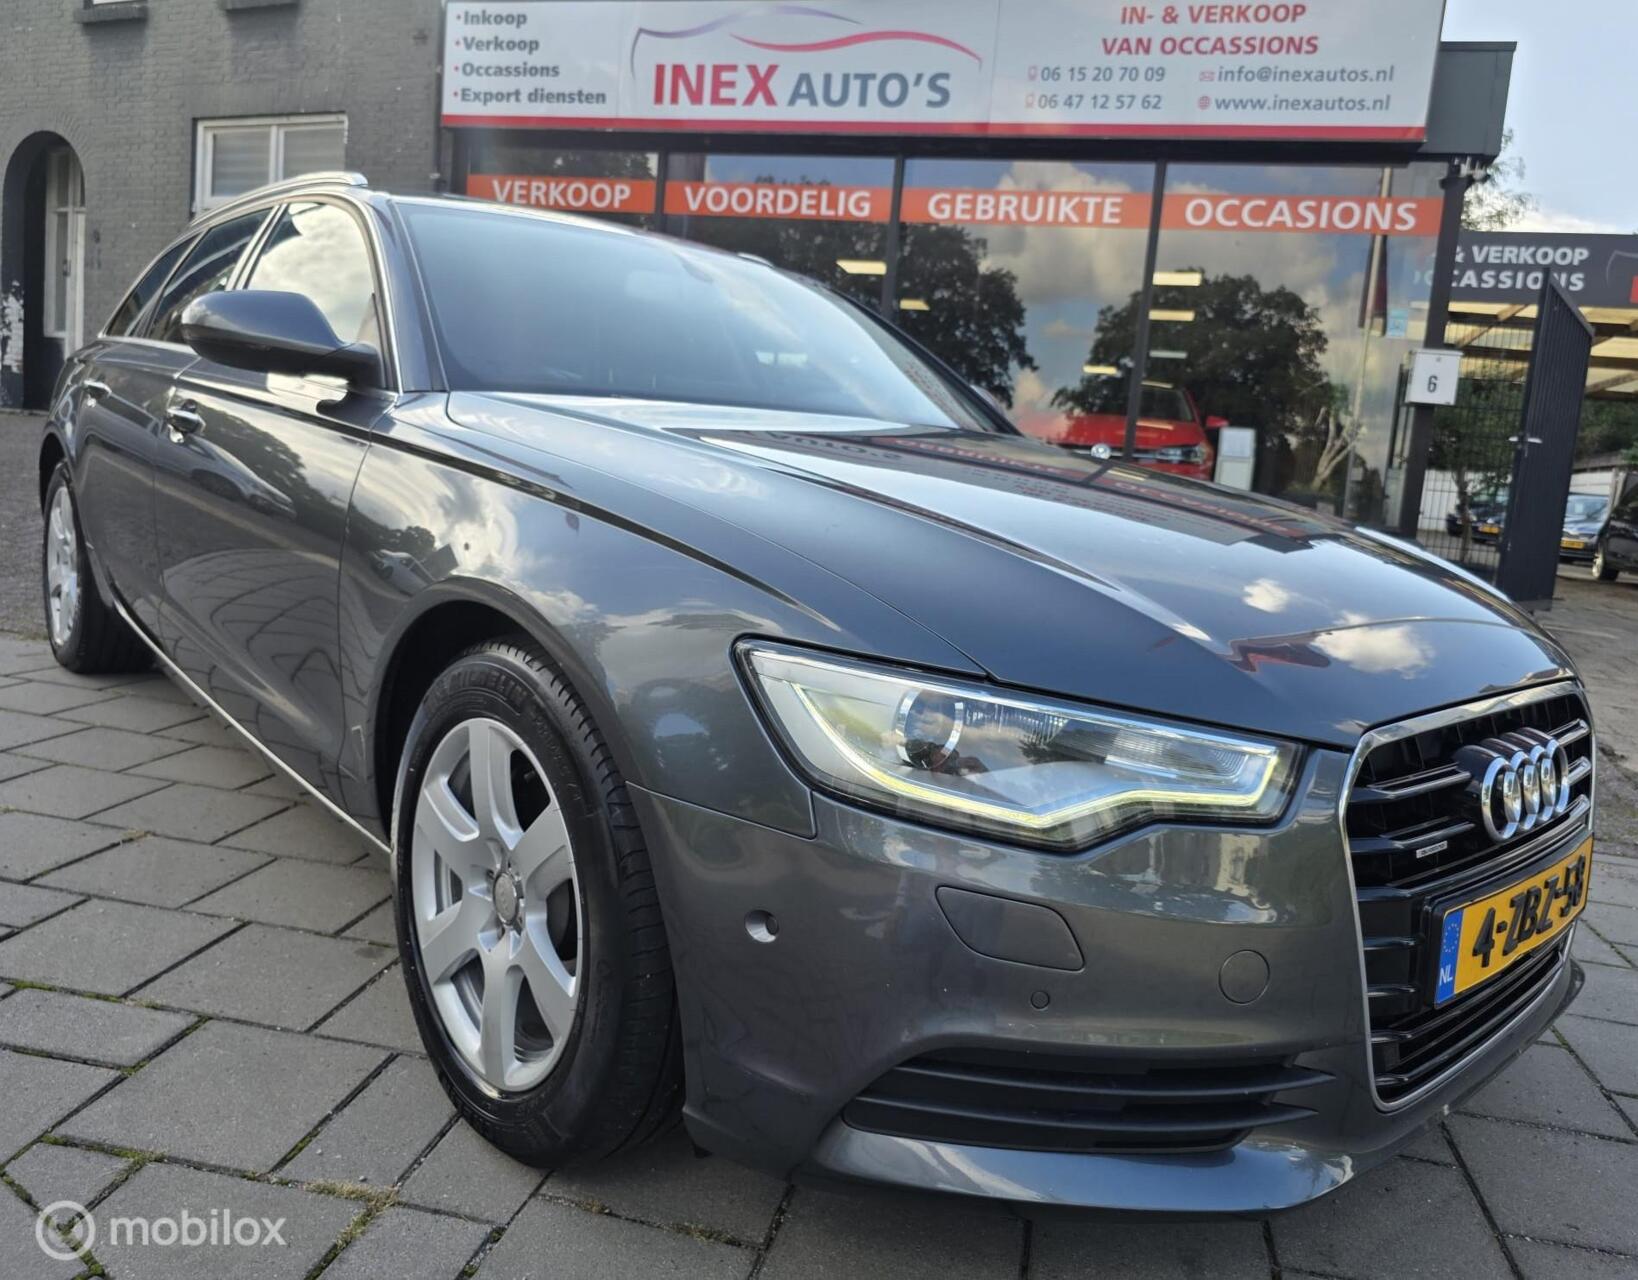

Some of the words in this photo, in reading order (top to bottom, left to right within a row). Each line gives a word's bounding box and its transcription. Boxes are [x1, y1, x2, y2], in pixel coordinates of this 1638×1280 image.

[463, 10, 528, 29] Inkoop
[1120, 6, 1155, 25] IN-
[1161, 5, 1179, 24] &
[1188, 4, 1307, 24] VERKOOP
[462, 36, 540, 55] Verkoop
[1101, 37, 1153, 56] VAN
[1160, 36, 1319, 56] OCCASSIONS
[461, 62, 561, 78] Occassions
[1040, 66, 1061, 82] 06
[1068, 66, 1087, 82] 15
[1092, 66, 1113, 82] 20
[1119, 66, 1140, 82] 70
[1144, 66, 1166, 82] 09
[1217, 65, 1395, 83] info@inexautos.nl
[653, 63, 780, 107] INEX
[787, 72, 952, 109] AUTO'S
[460, 88, 522, 106] Export
[527, 87, 607, 105] diensten
[1037, 94, 1059, 110] 06
[1063, 94, 1084, 110] 47
[1091, 94, 1110, 110] 12
[1115, 94, 1137, 110] 57
[1141, 94, 1163, 110] 62
[1214, 94, 1392, 112] www.inexautos.nl
[491, 179, 631, 209] VERKOOP
[684, 185, 872, 218] VOORDELIG
[927, 193, 1123, 226] GEBRUIKTE
[1184, 198, 1418, 232] OCCASIONS
[1471, 245, 1590, 266] VERKOOP
[1427, 375, 1438, 393] 6
[1439, 965, 1453, 984] NL
